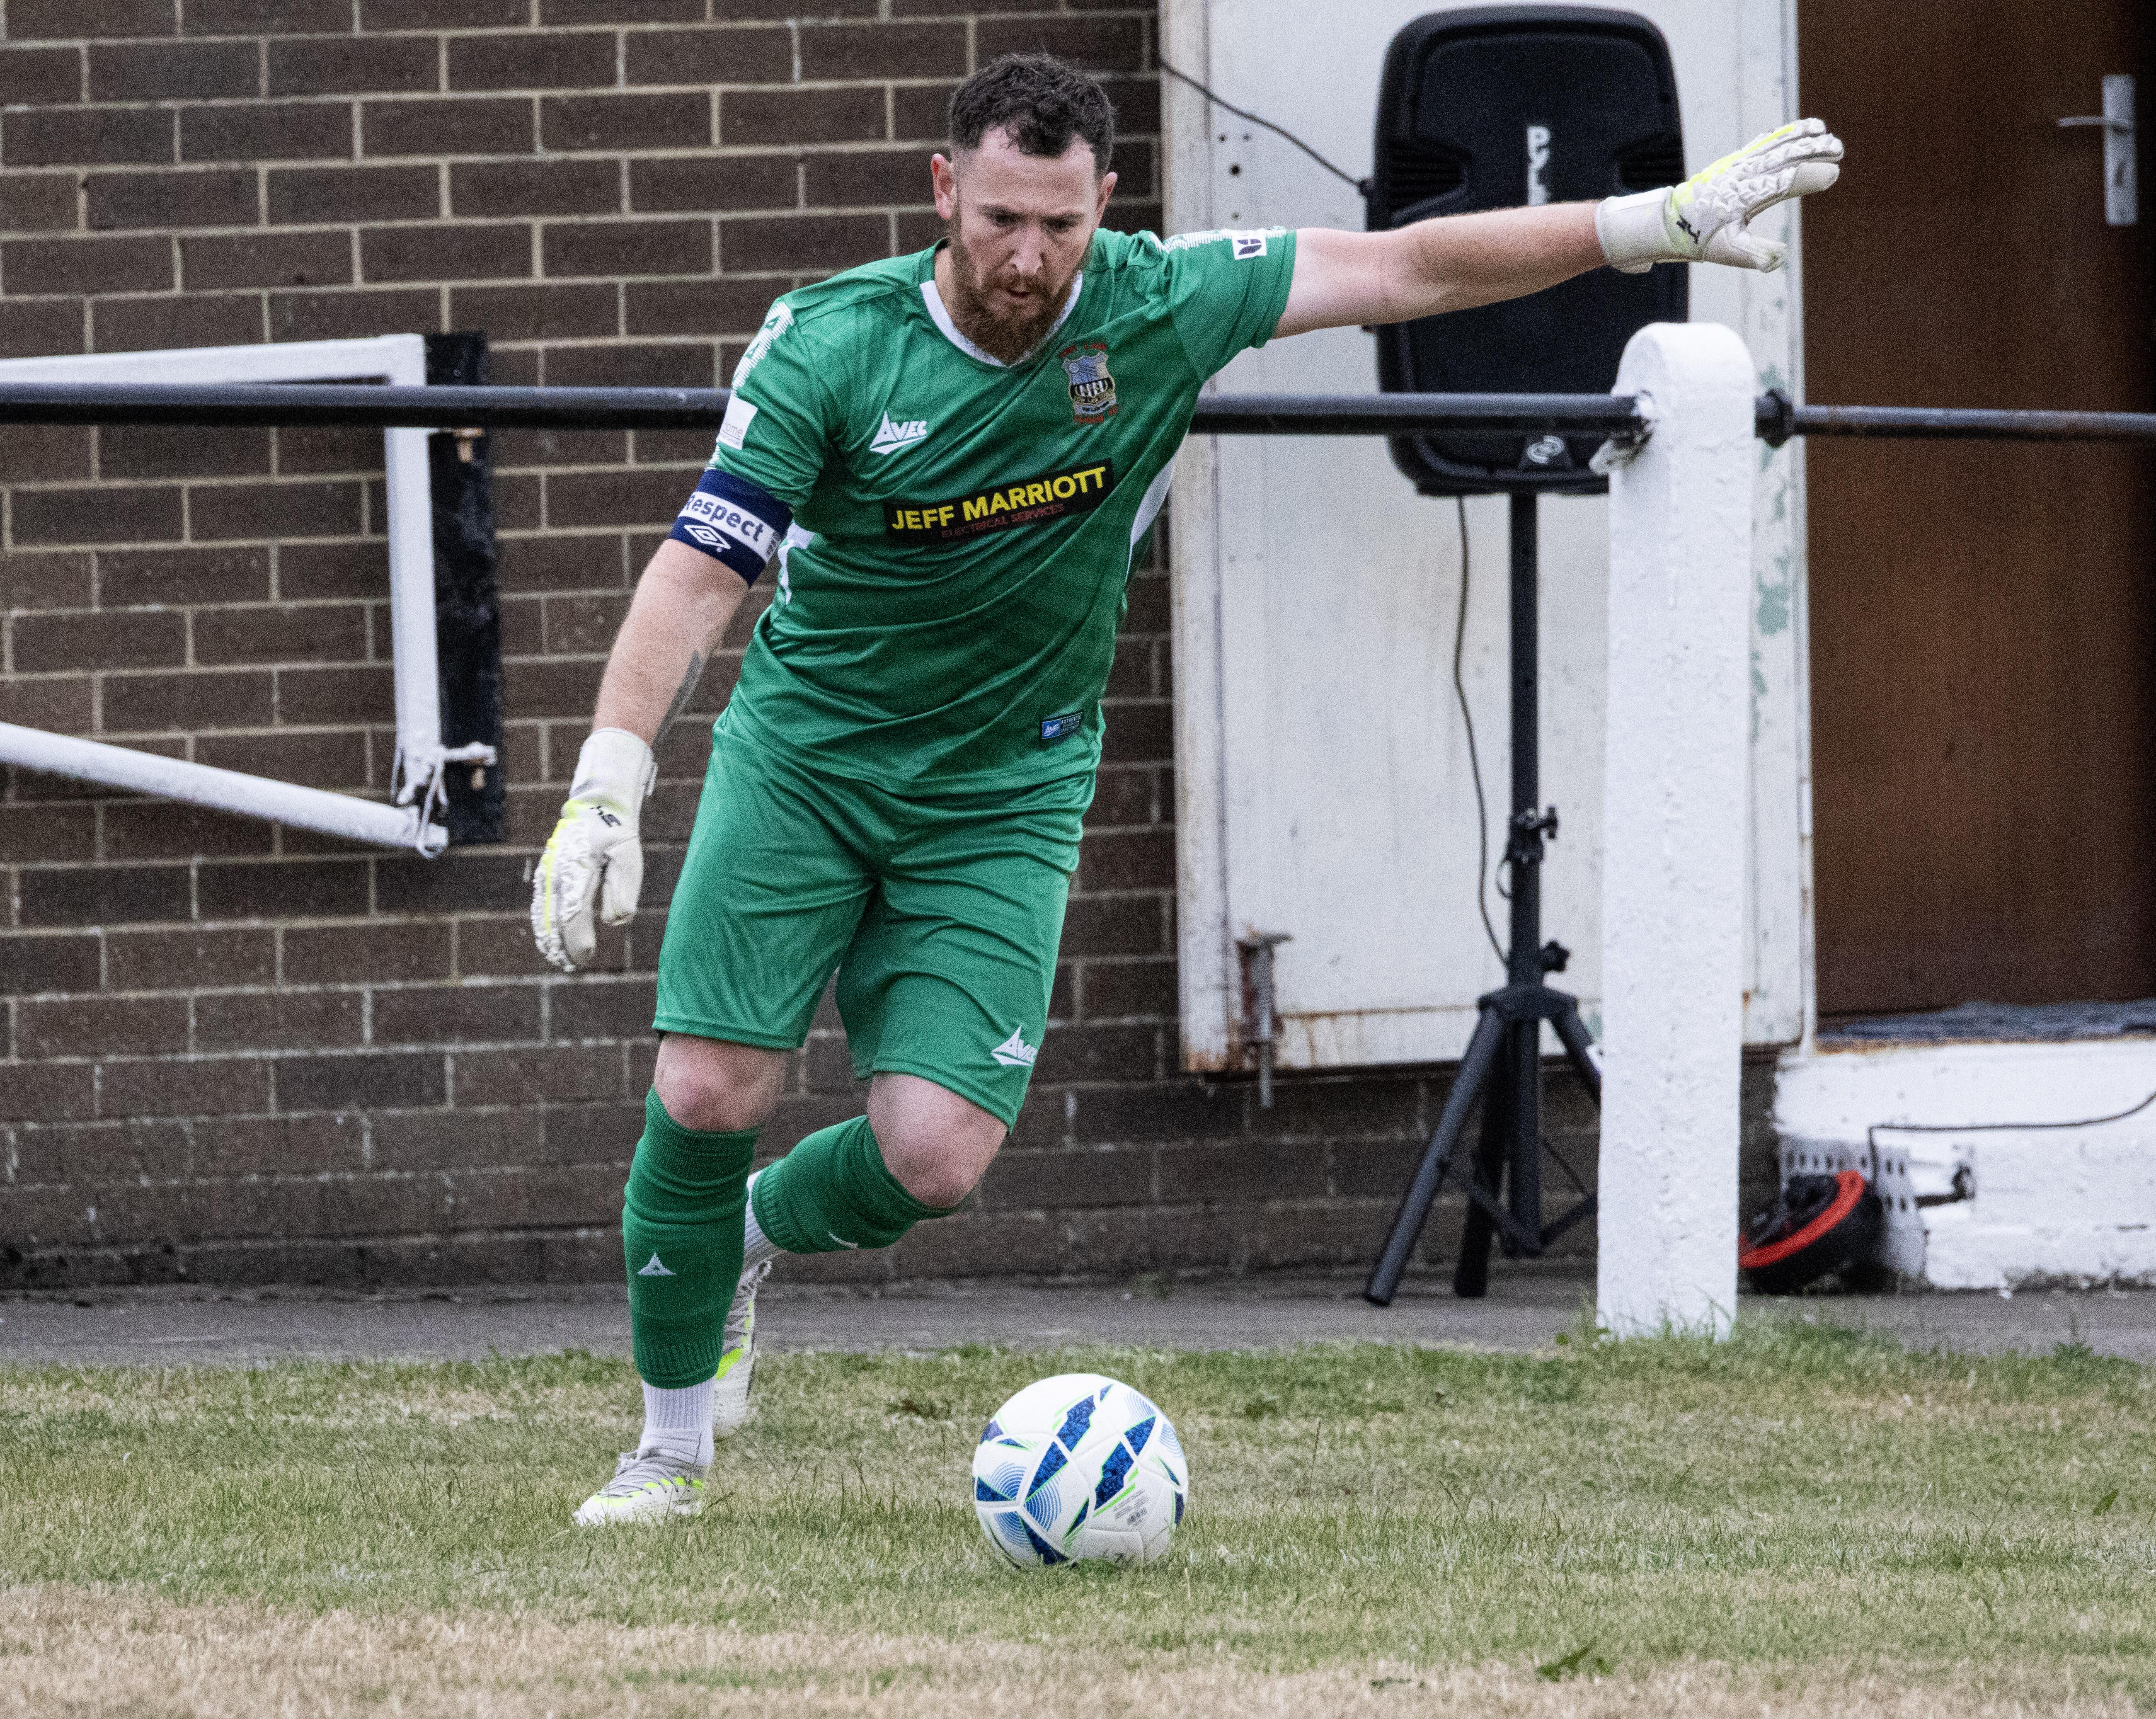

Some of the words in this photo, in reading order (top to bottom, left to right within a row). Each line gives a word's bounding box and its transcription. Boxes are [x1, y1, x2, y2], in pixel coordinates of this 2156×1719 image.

[869, 411, 927, 455] AVEC
[891, 505, 954, 530] JEFF
[962, 466, 1106, 521] MARRIOTT
[941, 514, 1008, 538] ELECTRICAL
[1011, 503, 1064, 523] SERVICES
